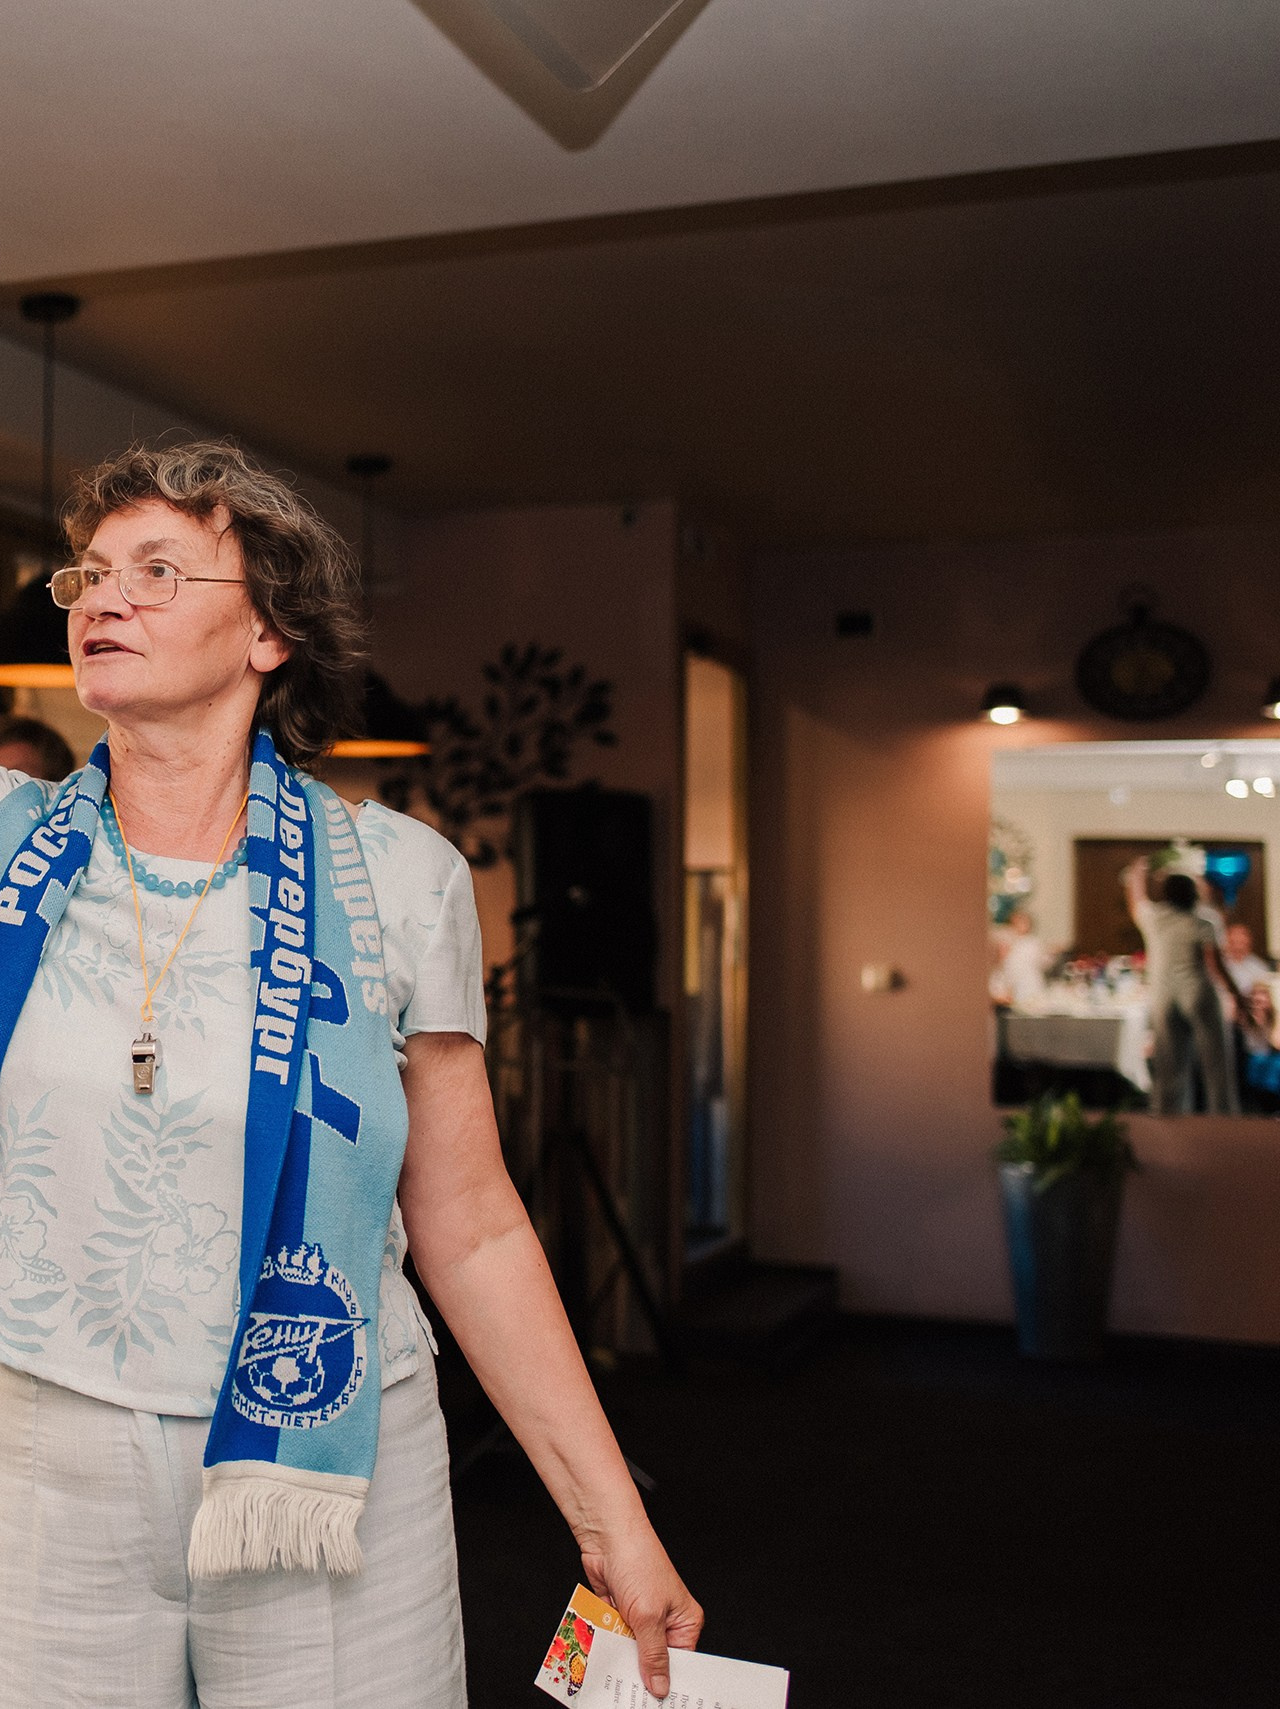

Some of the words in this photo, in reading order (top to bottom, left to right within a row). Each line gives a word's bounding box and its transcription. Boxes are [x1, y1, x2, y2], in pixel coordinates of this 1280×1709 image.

[255, 755, 312, 1085] -Петербург
[330, 1271, 358, 1316] КЛУБ
[232, 1356, 364, 1429] АНКТ-ПЕТЕРБУРГ
